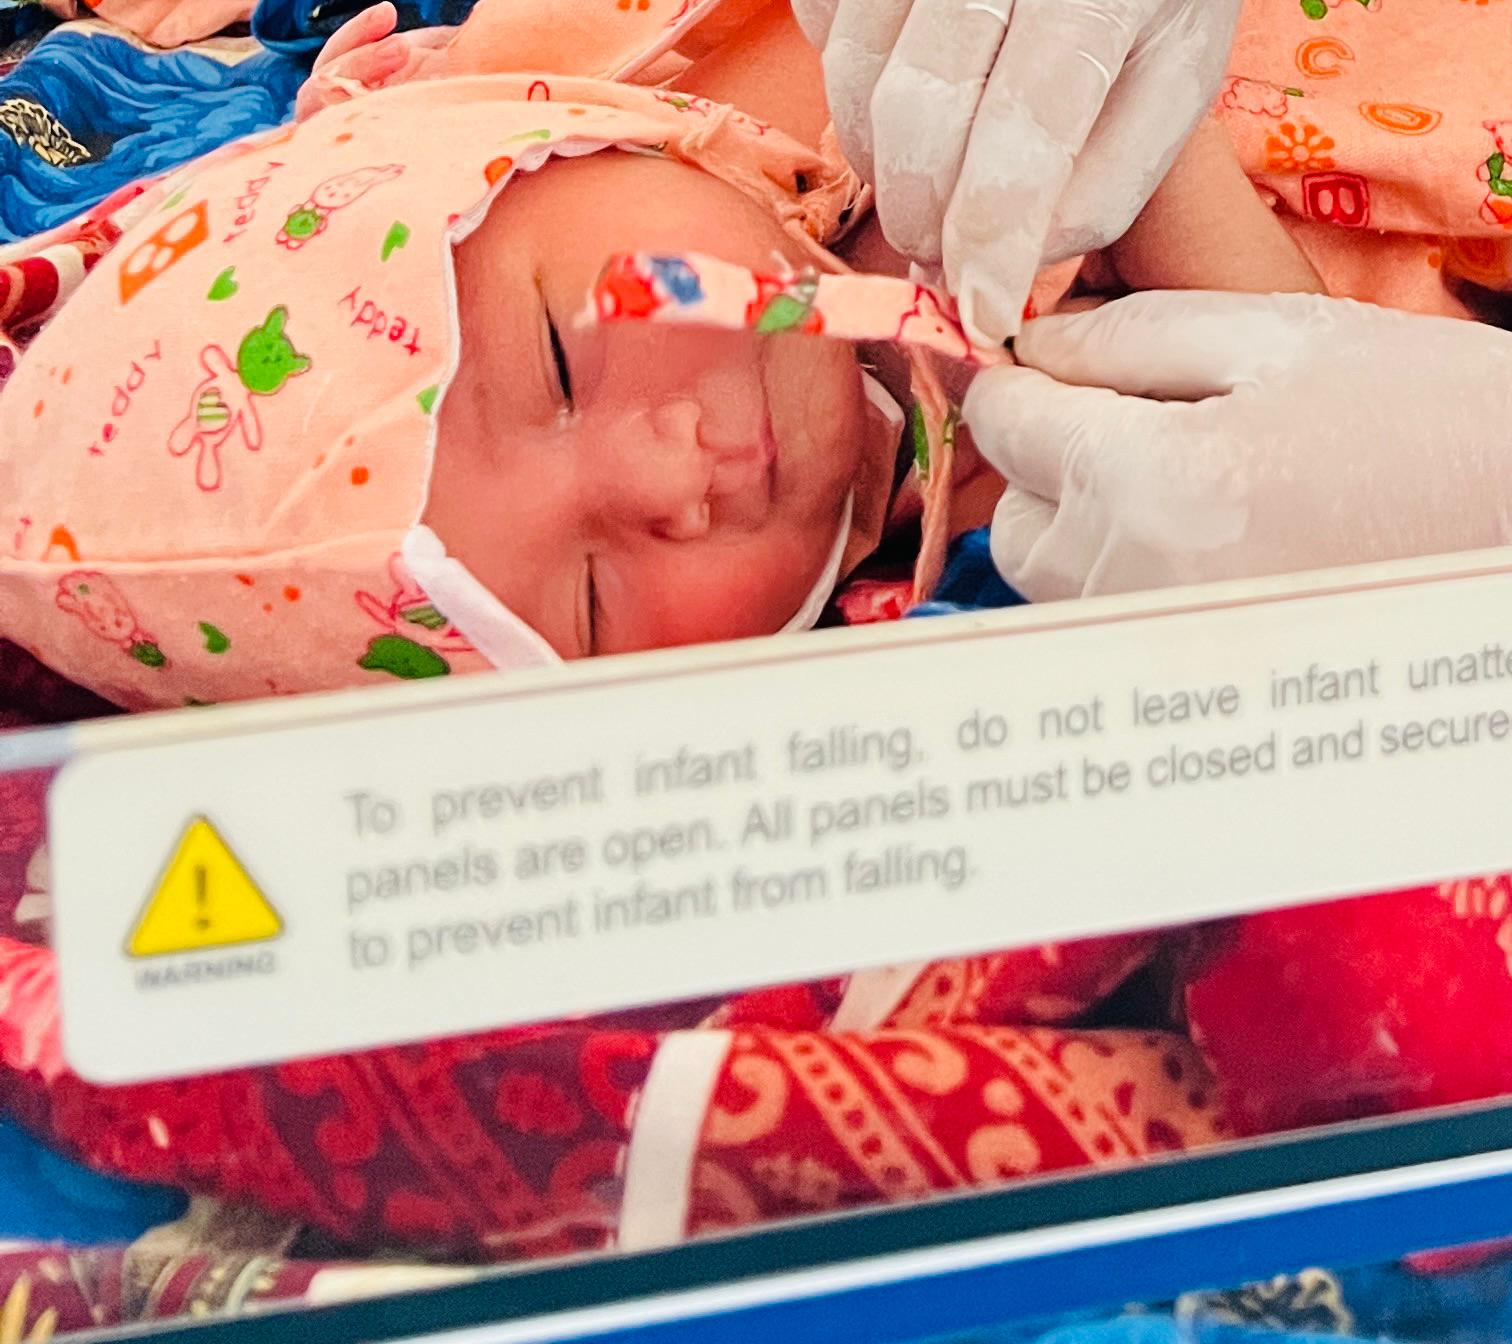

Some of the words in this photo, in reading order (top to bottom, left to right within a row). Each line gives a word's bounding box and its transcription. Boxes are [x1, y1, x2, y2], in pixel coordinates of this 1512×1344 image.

[338, 286, 423, 357] teddy
[87, 338, 163, 458] teddy
[346, 791, 398, 837] To
[430, 765, 603, 835] prevent
[634, 742, 758, 797] infant
[956, 709, 1009, 754] do
[1039, 695, 1105, 742] not
[1132, 682, 1241, 728] leave
[1270, 659, 1382, 711] infant
[344, 847, 498, 914] panels
[513, 840, 587, 883] are
[602, 816, 726, 878] open.
[742, 802, 793, 849] All
[809, 781, 950, 849] panels
[966, 762, 1070, 814] must
[1082, 754, 1133, 796] be
[1146, 730, 1276, 789] closed
[1291, 719, 1365, 769] and
[347, 923, 389, 973] to
[406, 892, 579, 972] prevent
[594, 877, 718, 934] infant
[730, 859, 829, 910] from
[844, 841, 980, 898] falling.
[134, 950, 276, 993] WARNING
